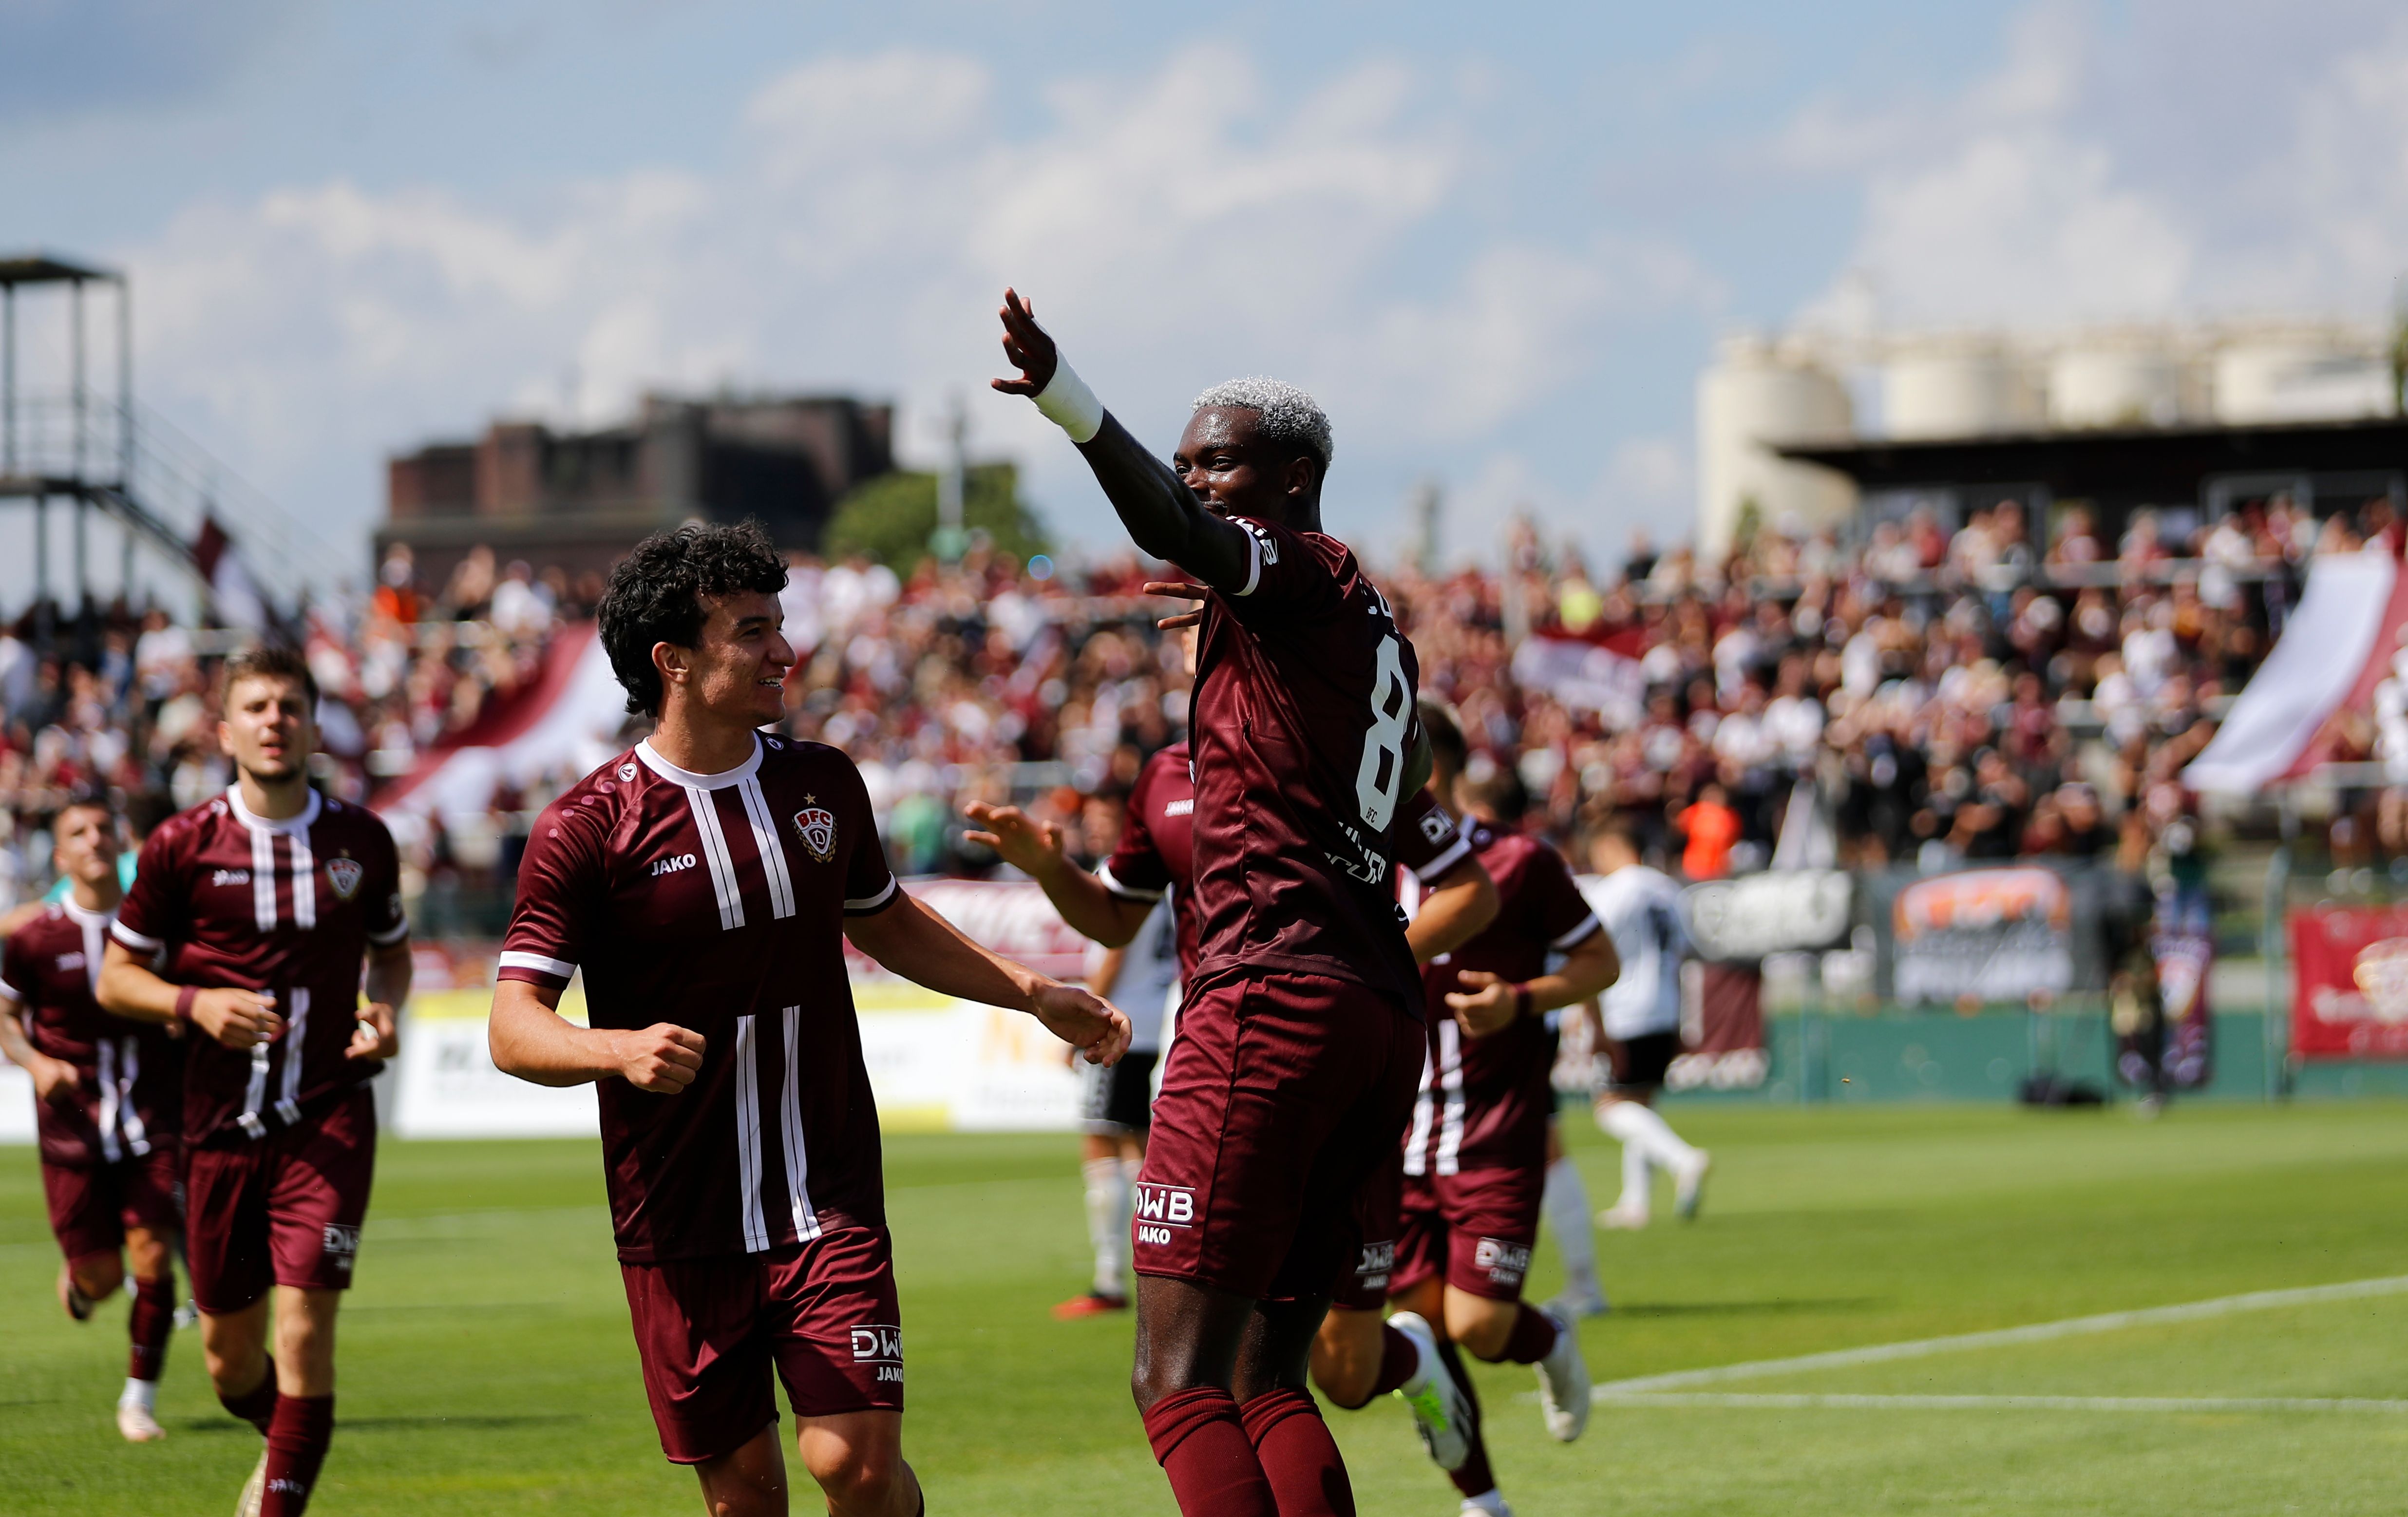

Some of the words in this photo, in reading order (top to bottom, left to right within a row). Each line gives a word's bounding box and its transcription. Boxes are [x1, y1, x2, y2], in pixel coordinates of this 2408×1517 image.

[1356, 634, 1412, 833] 8
[796, 810, 831, 828] BFC
[1366, 807, 1377, 823] BFC
[652, 853, 696, 876] JAKO
